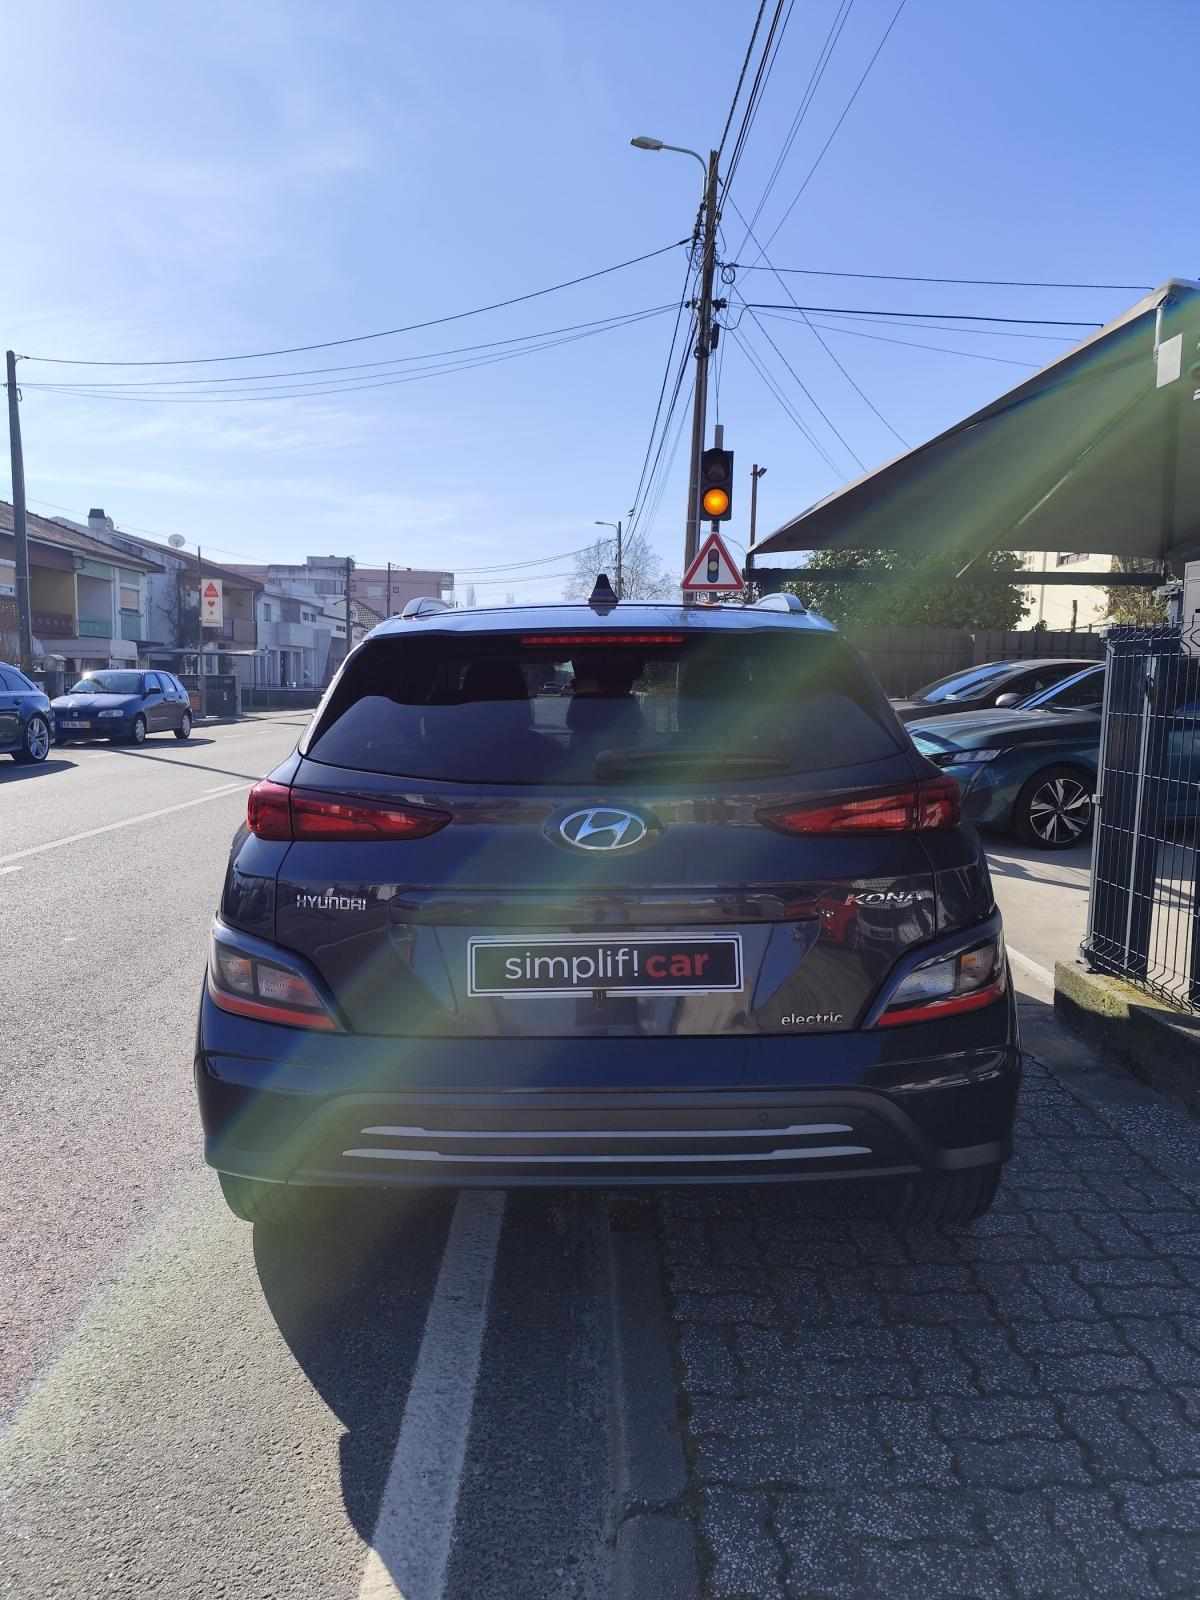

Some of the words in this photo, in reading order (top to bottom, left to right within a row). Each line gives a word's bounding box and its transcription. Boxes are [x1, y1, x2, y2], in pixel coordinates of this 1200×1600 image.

[296, 894, 367, 911] HYUNDAI
[844, 891, 922, 906] KONA
[645, 952, 709, 979] car
[781, 1011, 843, 1025] electric
